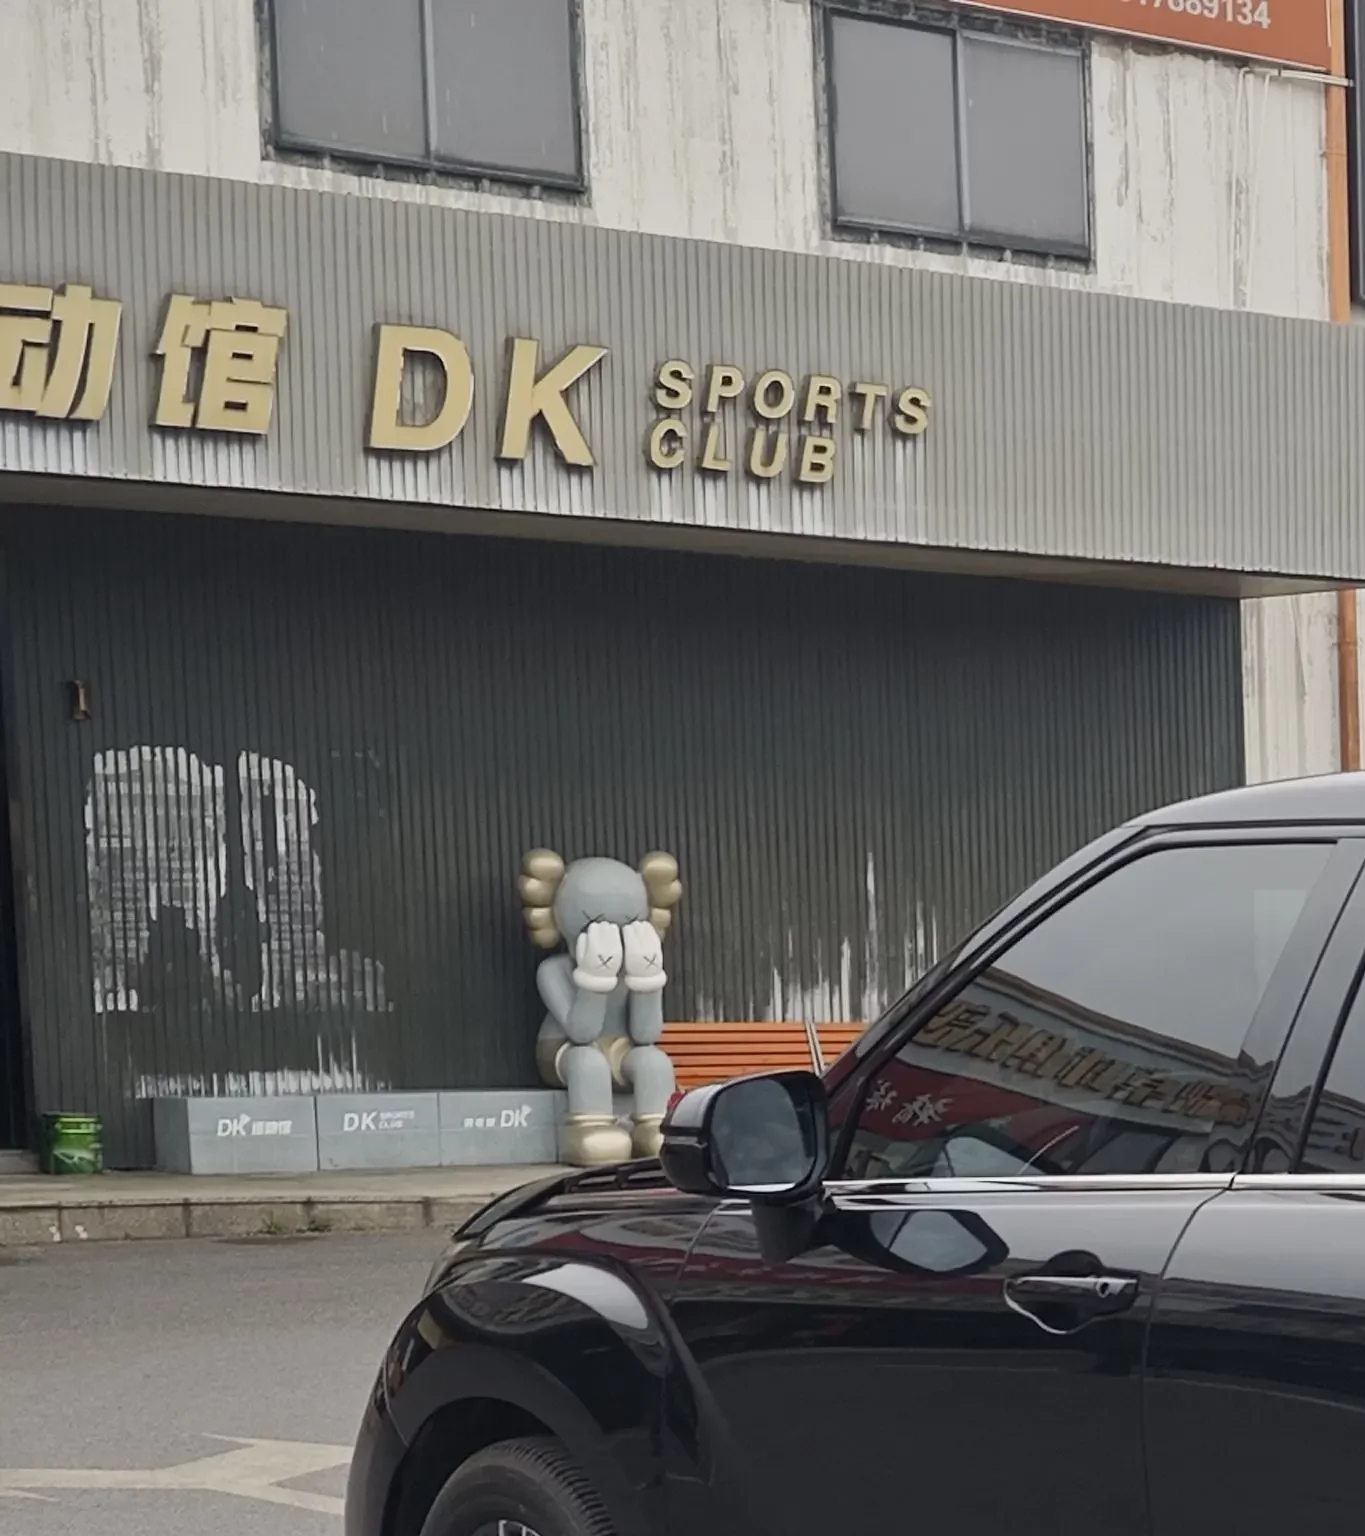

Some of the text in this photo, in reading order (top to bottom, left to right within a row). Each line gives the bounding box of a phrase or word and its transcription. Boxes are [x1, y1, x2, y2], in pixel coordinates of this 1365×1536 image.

[368, 322, 608, 467] DK
[654, 358, 932, 435] SPORTS
[650, 419, 836, 483] CLUB
[343, 1111, 378, 1131] DK
